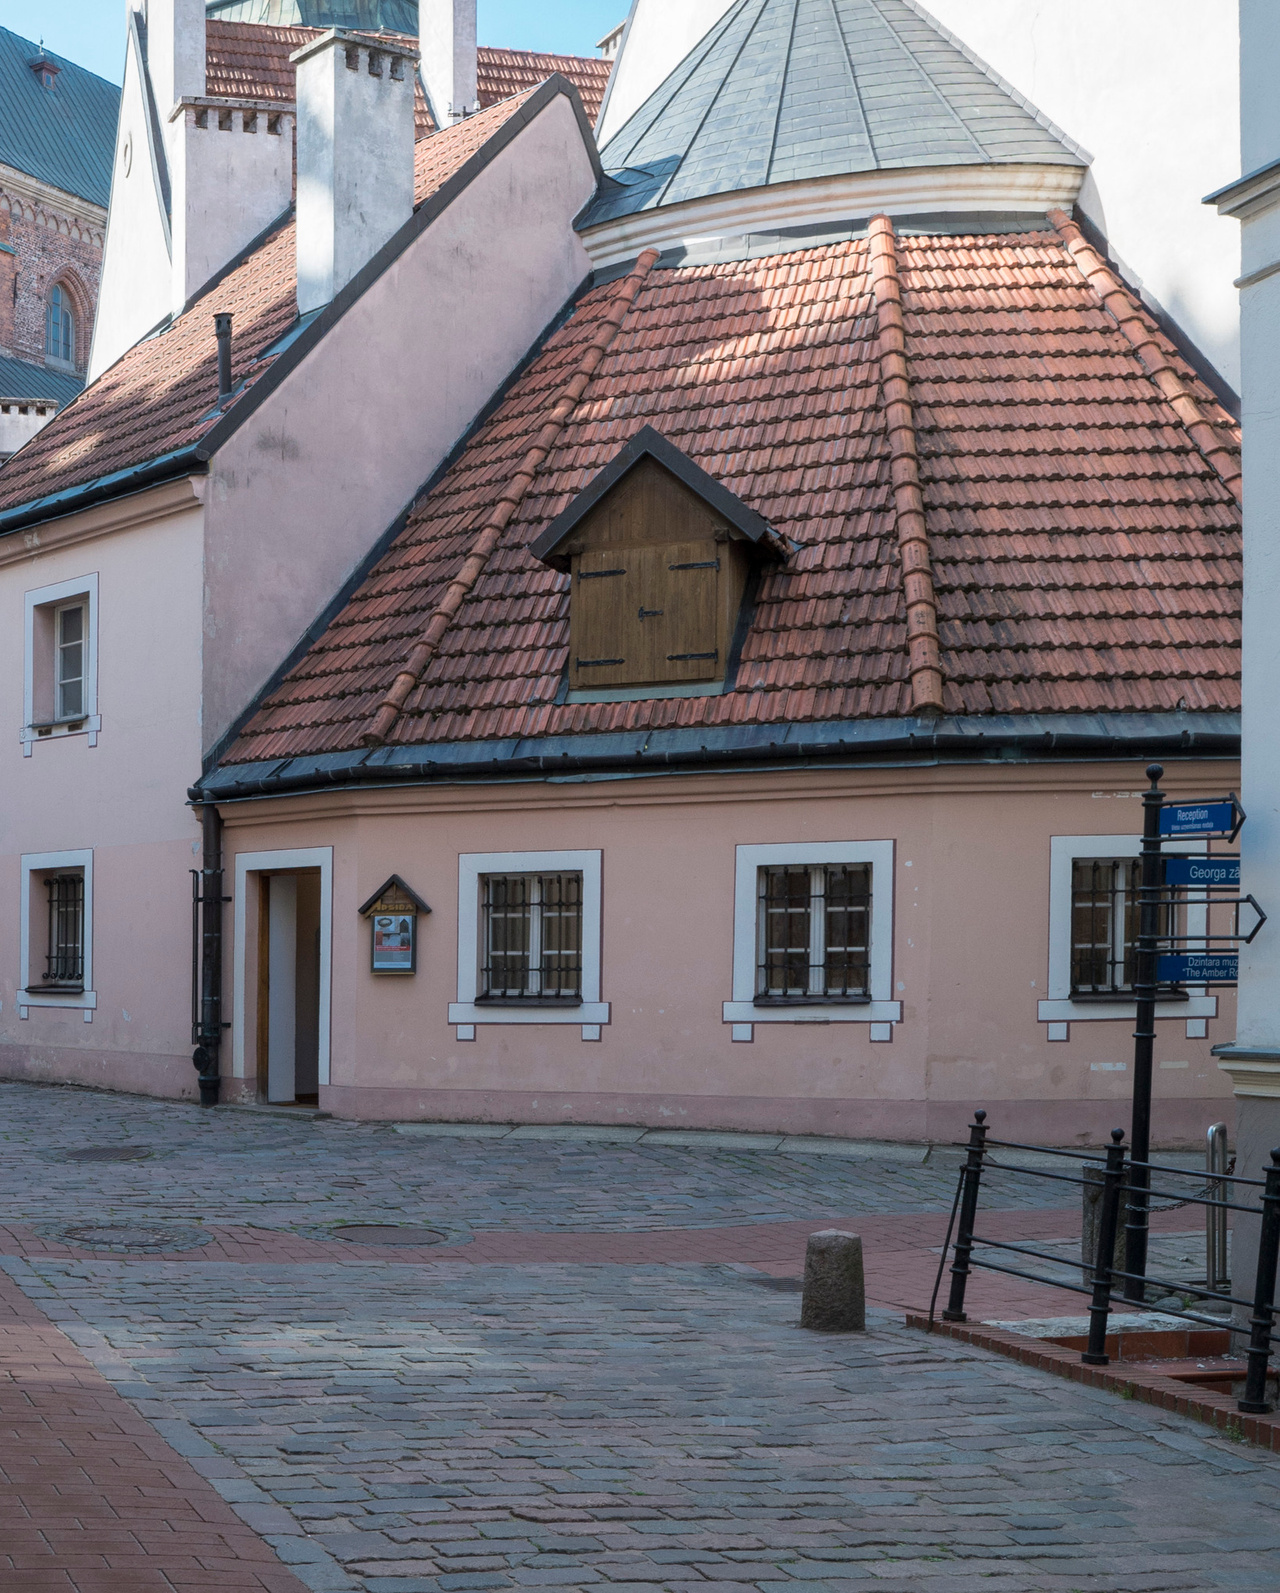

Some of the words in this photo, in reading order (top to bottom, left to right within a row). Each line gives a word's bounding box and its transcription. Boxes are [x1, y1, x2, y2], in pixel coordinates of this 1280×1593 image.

[1177, 808, 1209, 823] Reception
[1189, 865, 1226, 882] Georga
[1188, 956, 1220, 967] Dzintara
[1202, 968, 1228, 978] Amber
